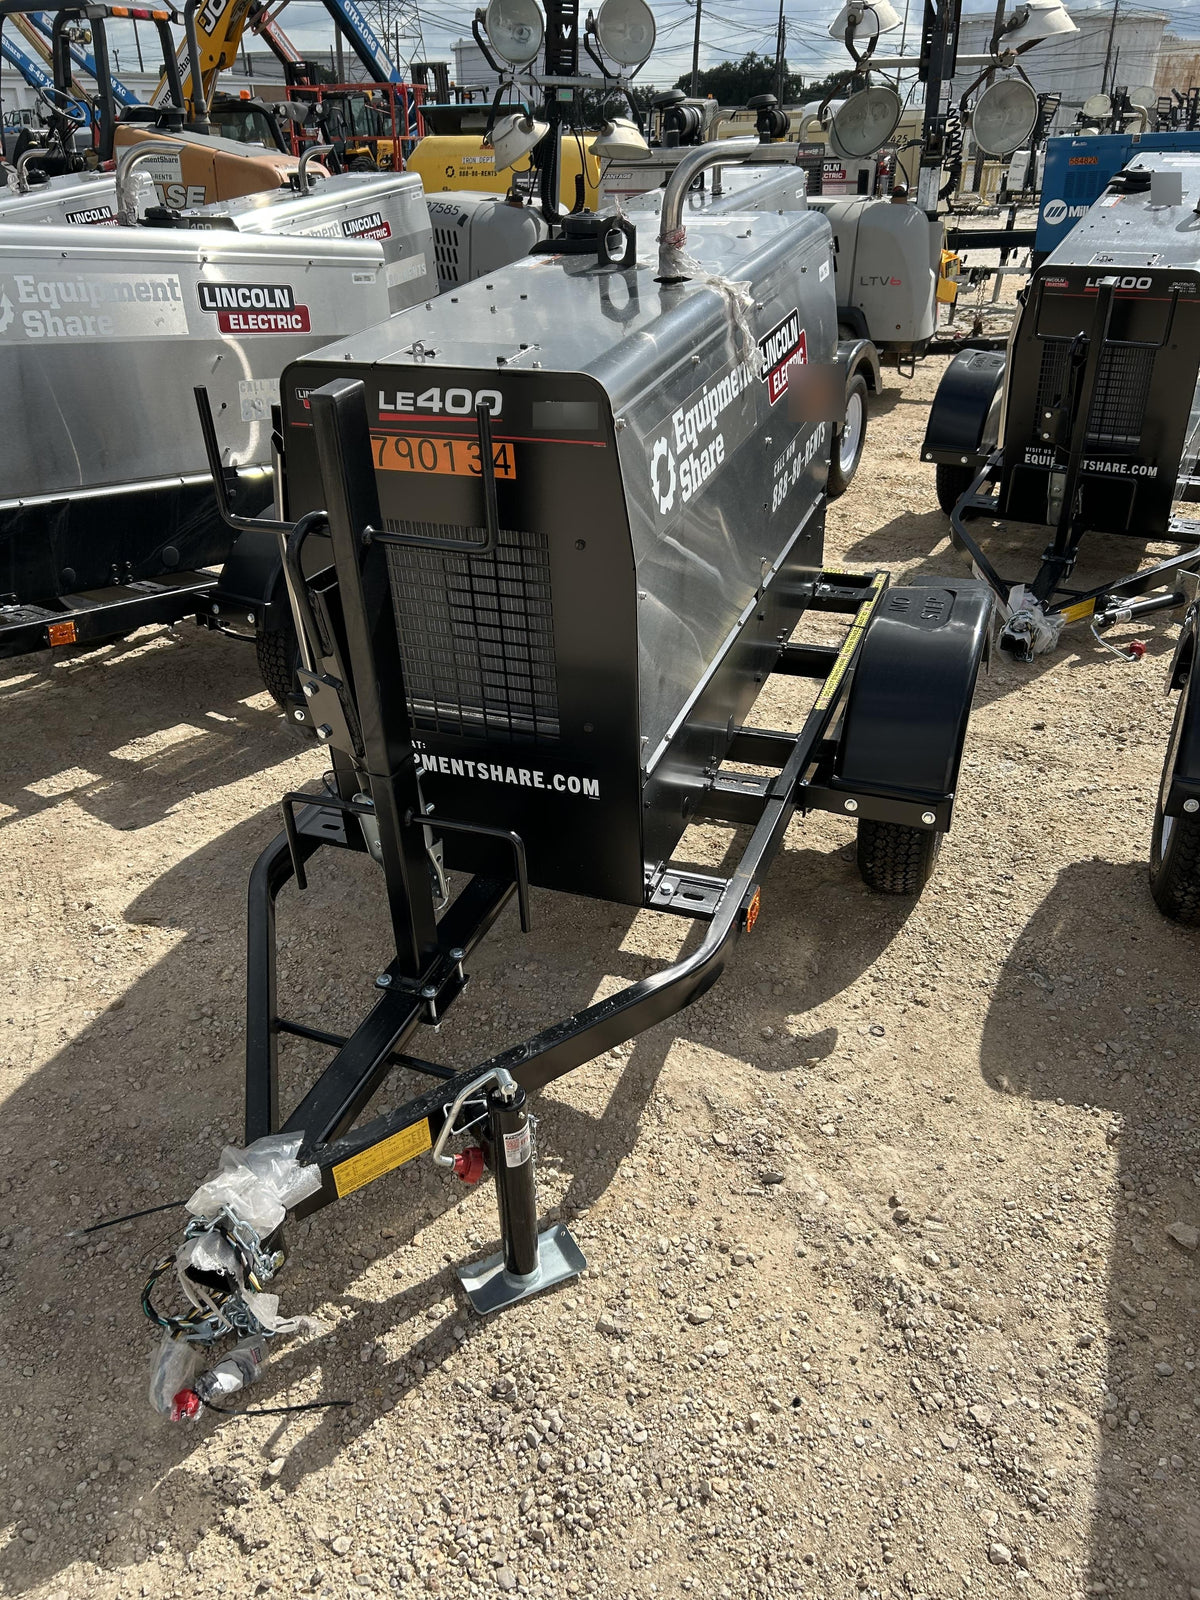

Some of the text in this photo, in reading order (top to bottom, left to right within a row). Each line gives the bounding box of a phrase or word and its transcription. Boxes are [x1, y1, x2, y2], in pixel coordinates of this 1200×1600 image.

[68, 207, 111, 224] LINCOLN
[343, 213, 381, 235] LINCOLN
[14, 274, 181, 310] Equipment
[203, 286, 291, 309] LINCOLN
[22, 310, 114, 338] Share
[229, 313, 303, 330] ELECTRIC
[761, 315, 799, 375] LINCOLN
[378, 387, 503, 416] LE400
[679, 433, 724, 503] Share
[774, 454, 785, 478] CALL
